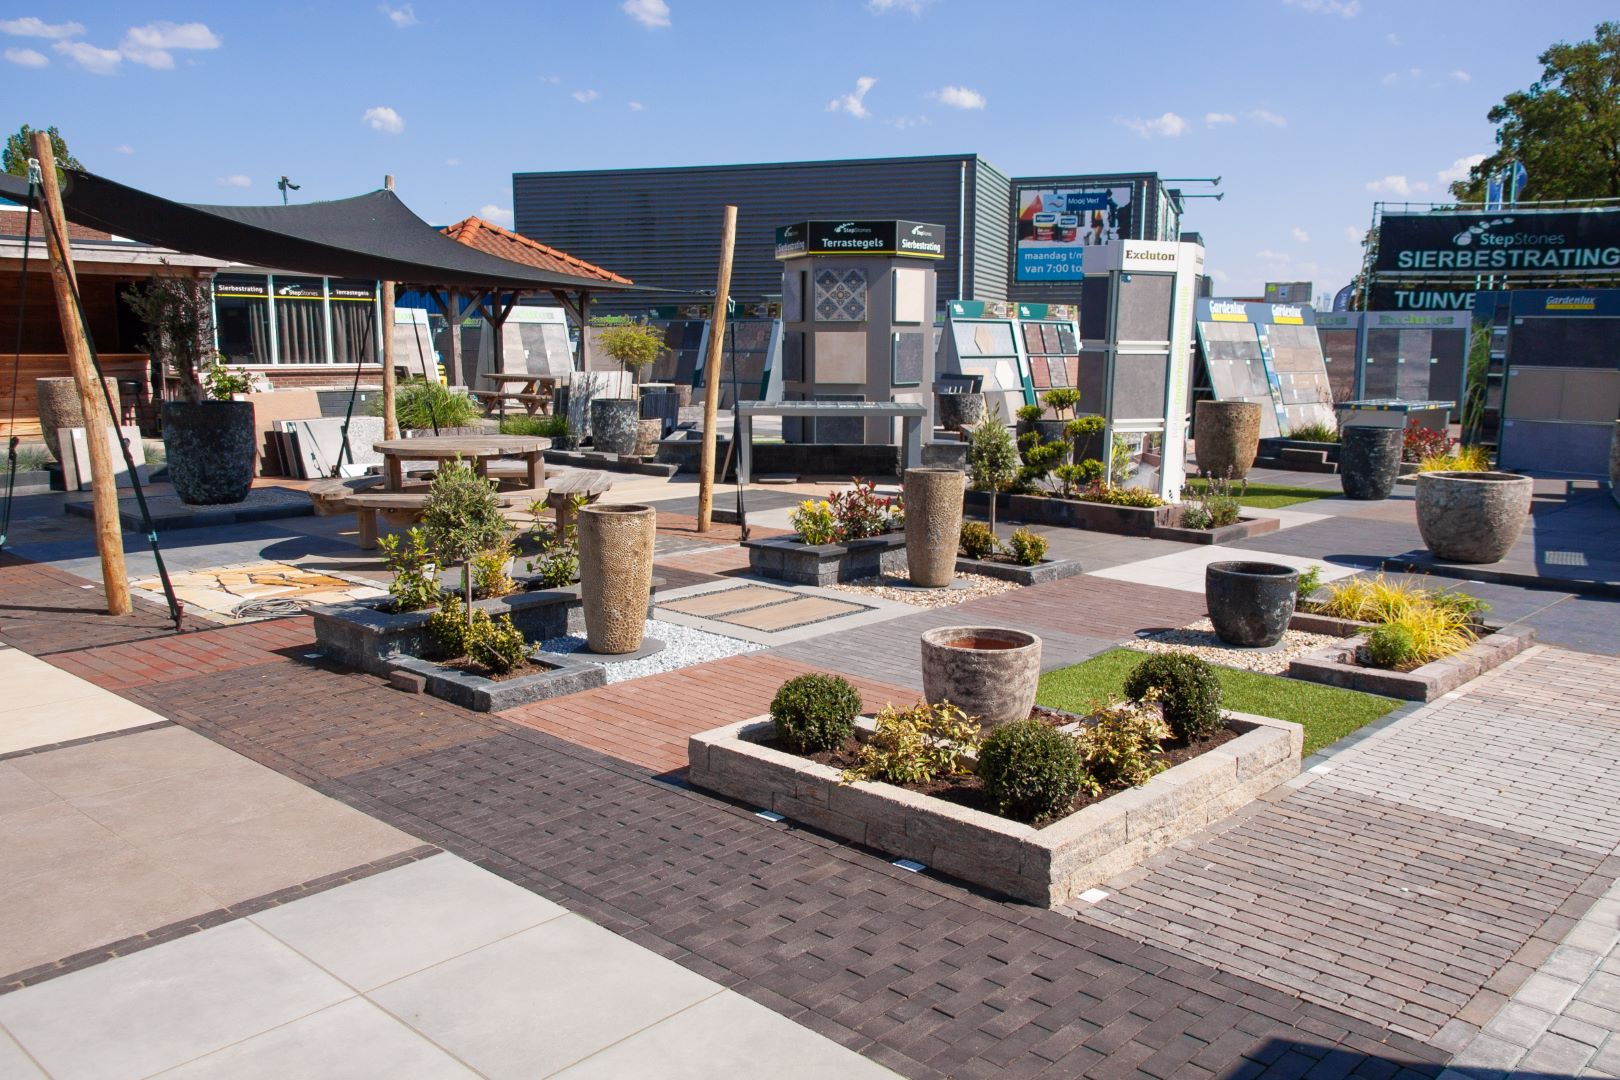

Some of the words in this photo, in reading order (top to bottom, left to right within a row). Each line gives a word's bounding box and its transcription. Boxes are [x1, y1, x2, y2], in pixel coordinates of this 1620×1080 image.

[821, 238, 884, 249] Terrastegels
[1480, 233, 1566, 247] StepStones
[901, 239, 941, 254] Sierbestrating
[1024, 251, 1067, 261] maandag
[1125, 249, 1175, 261] Excluton
[1398, 247, 1620, 268] SIERBESTRATING
[1025, 265, 1044, 273] van
[1046, 264, 1069, 273] 7:00
[218, 285, 263, 294] Sierbestrating
[1546, 296, 1595, 305] Gardenlux
